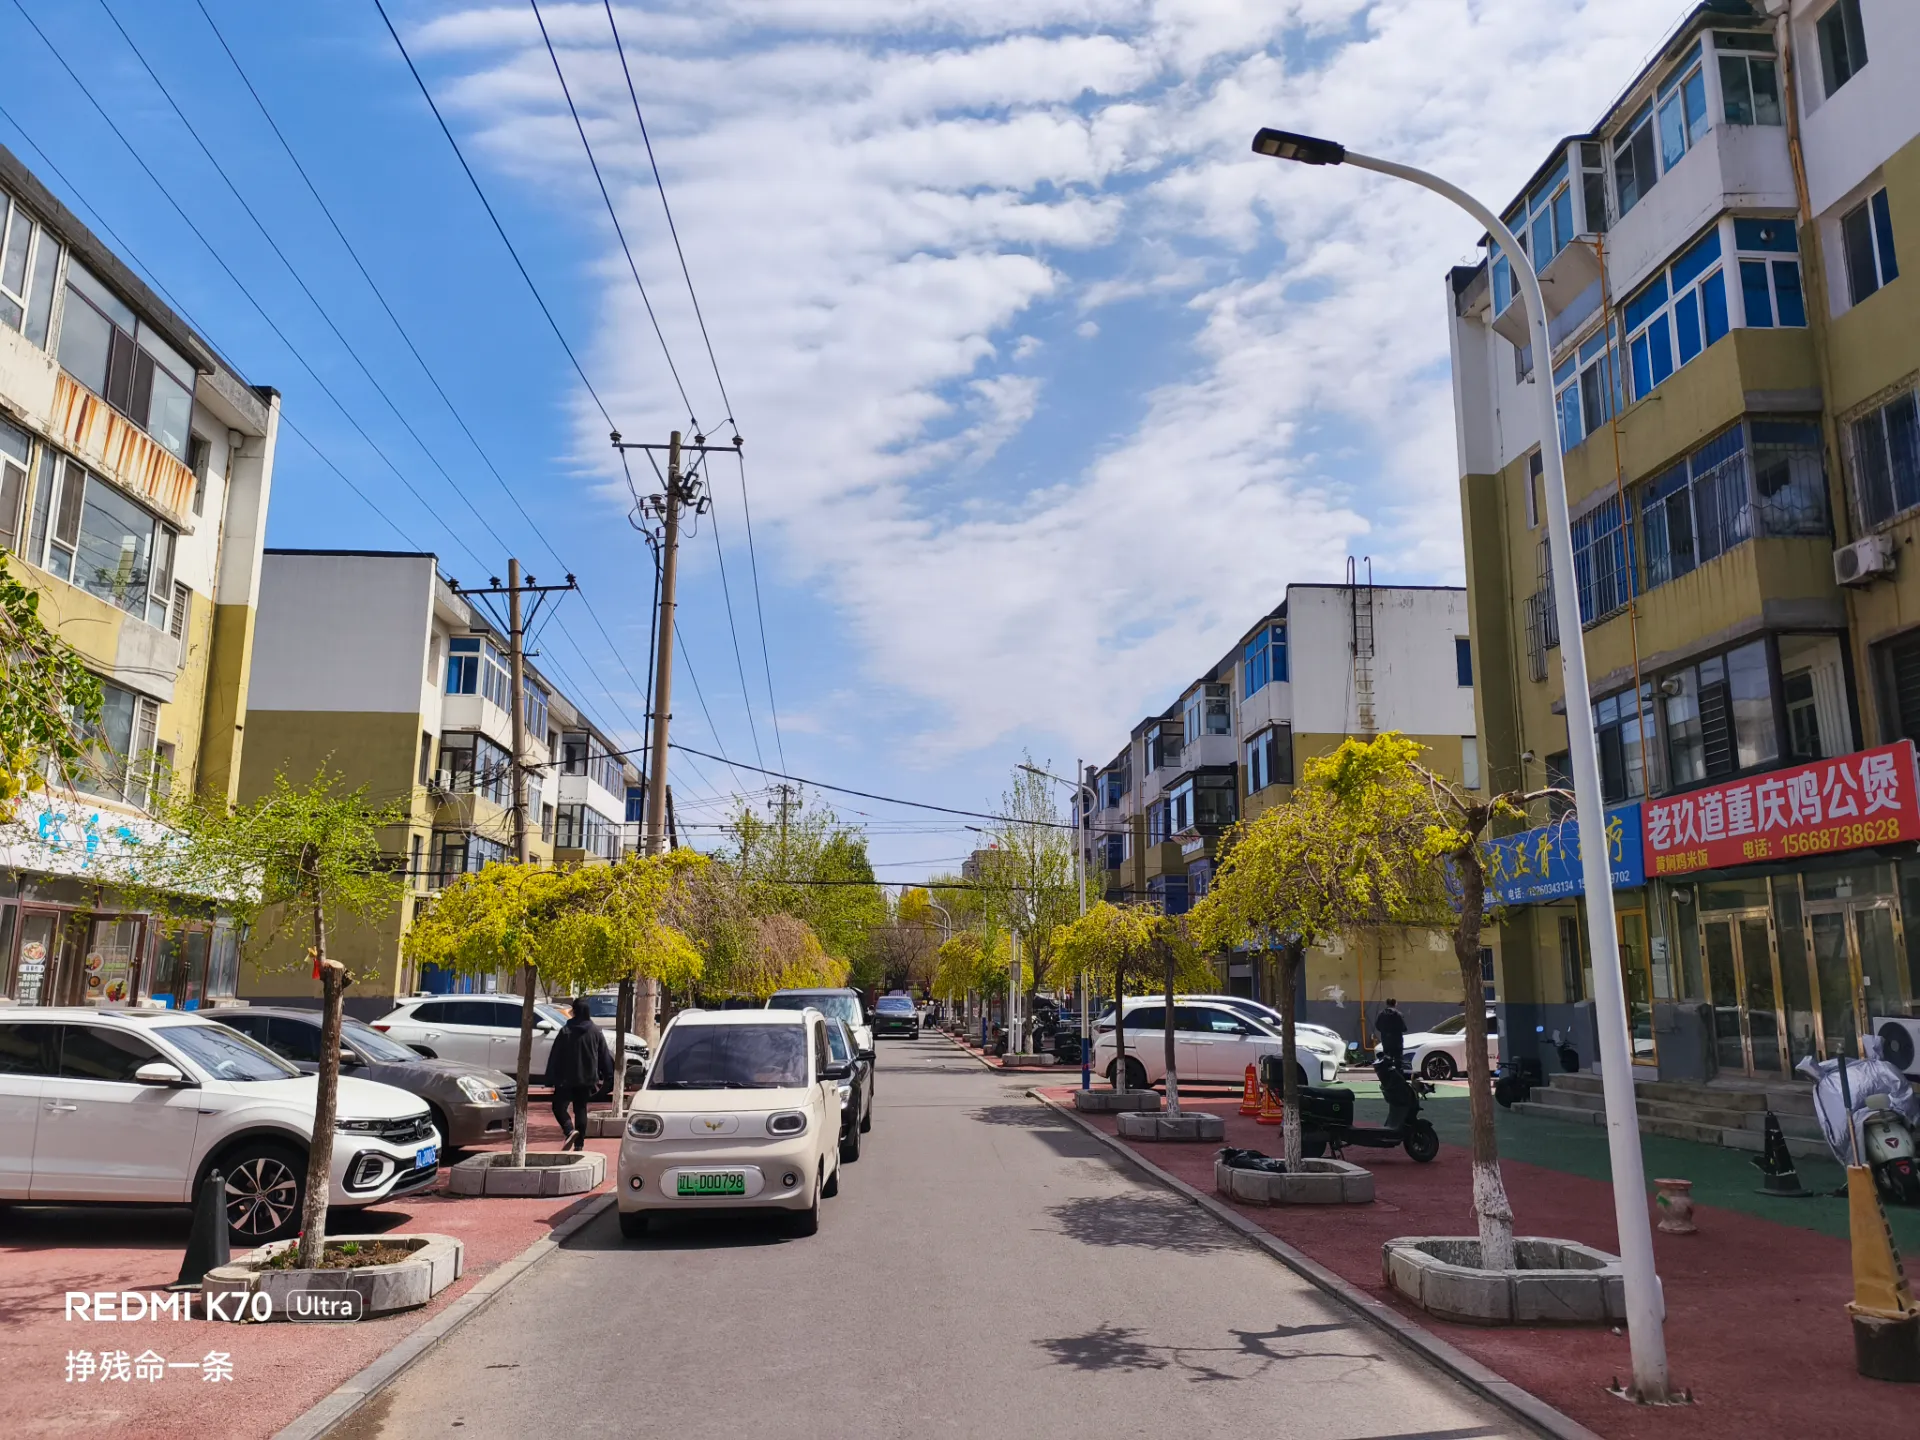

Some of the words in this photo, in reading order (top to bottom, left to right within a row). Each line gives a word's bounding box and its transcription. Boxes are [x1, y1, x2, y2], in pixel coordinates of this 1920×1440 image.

[1648, 753, 1901, 850] 老玖道重庆鸡公煲
[1780, 817, 1899, 854] 15668738628
[1656, 849, 1708, 873] 黄焖鸡米饭
